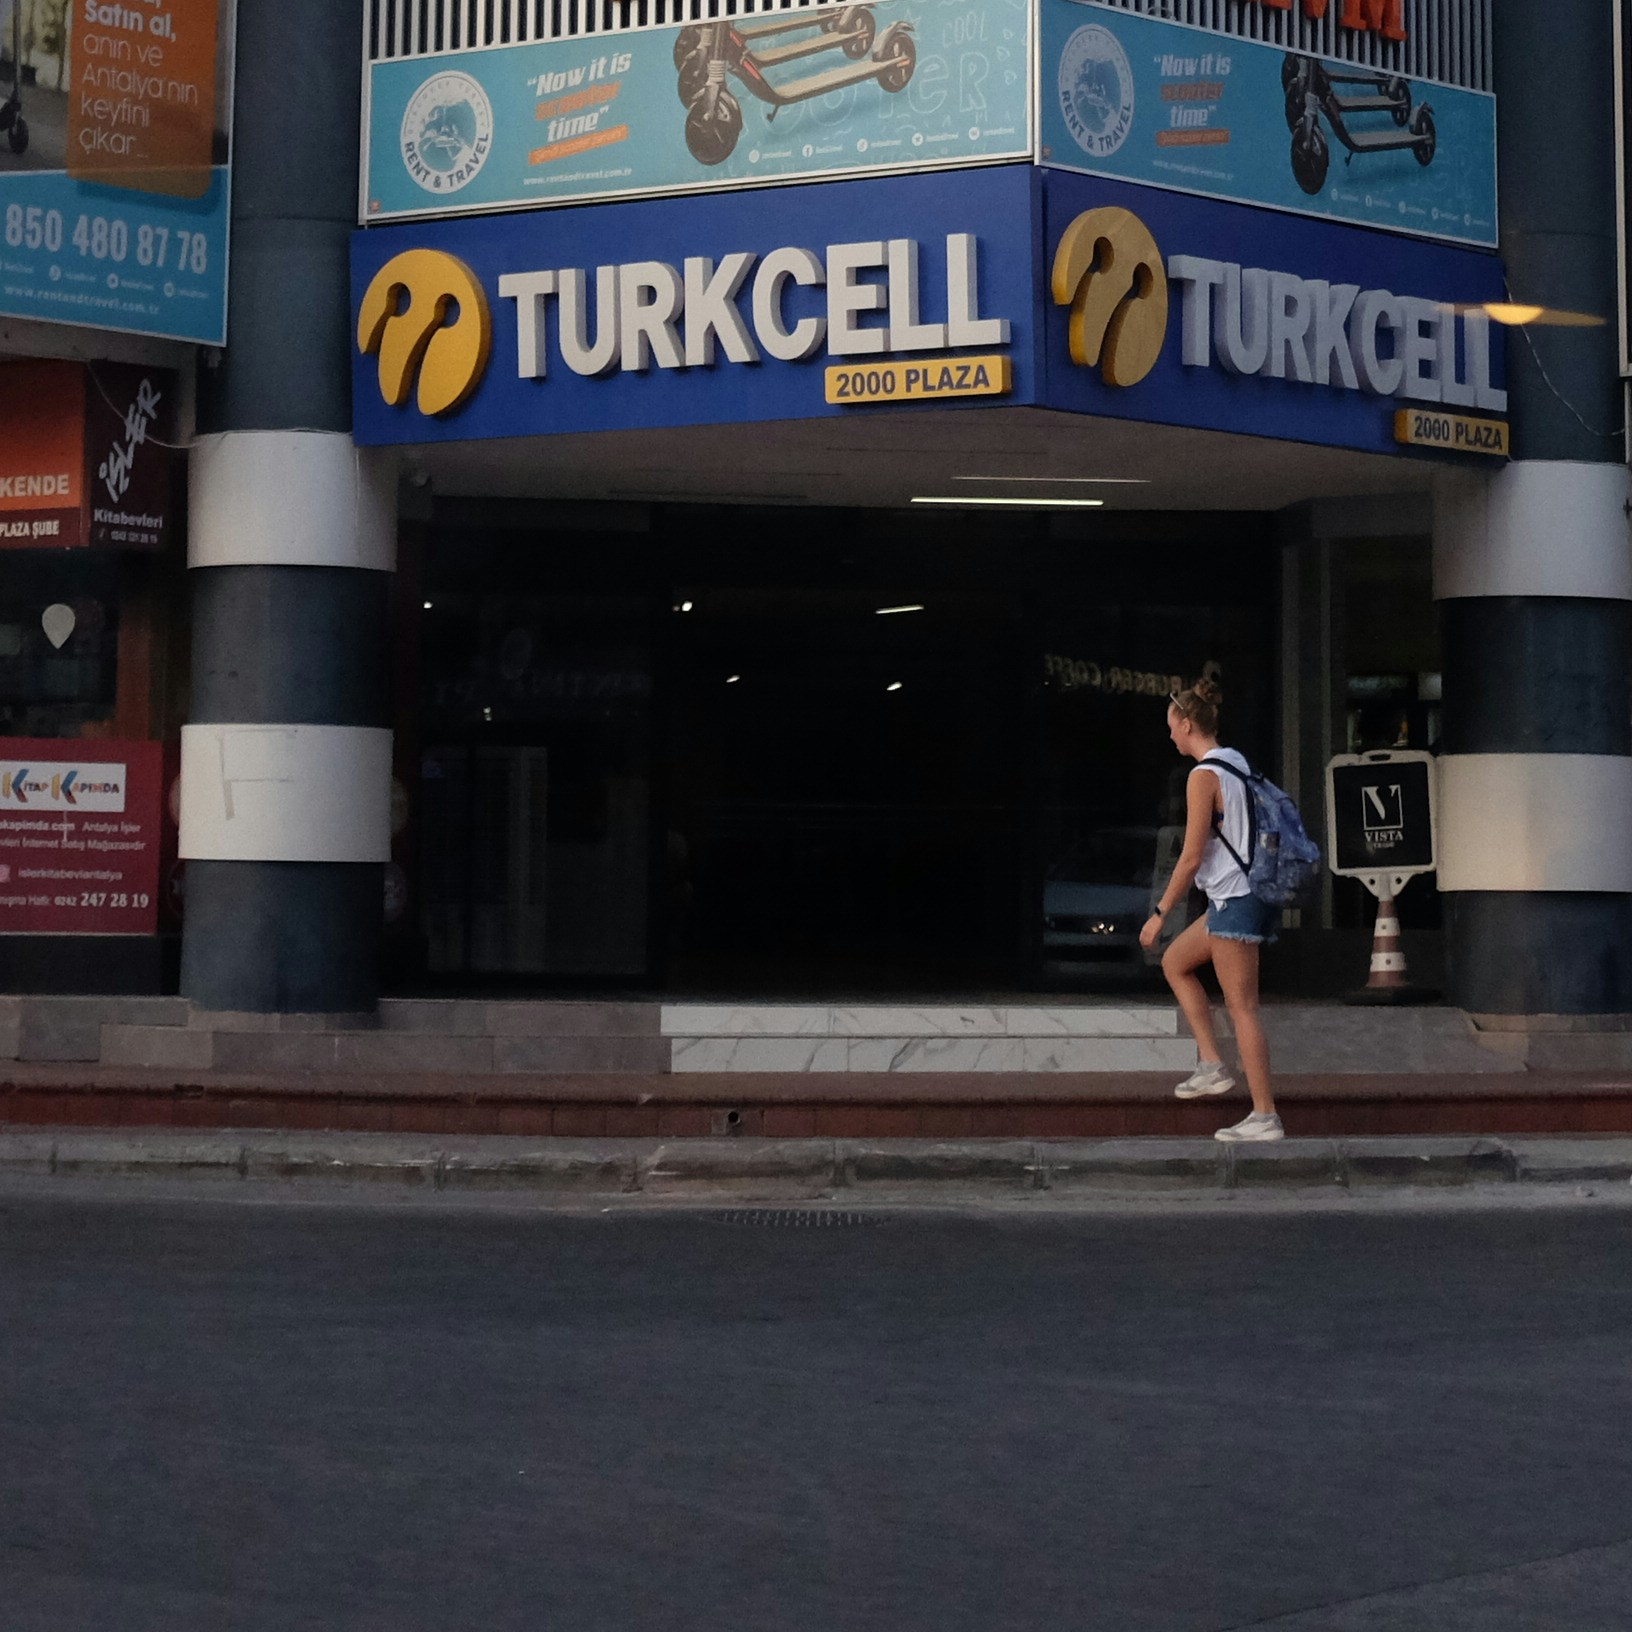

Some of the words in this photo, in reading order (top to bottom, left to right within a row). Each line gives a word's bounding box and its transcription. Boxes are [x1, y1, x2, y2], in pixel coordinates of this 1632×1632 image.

[84, 0, 144, 33] Satın
[148, 13, 177, 43] al,
[83, 33, 131, 61] anın
[137, 43, 164, 67] ve
[588, 56, 608, 81] it
[609, 52, 632, 75] is
[1200, 52, 1215, 75] it
[1215, 53, 1232, 76] is
[81, 91, 151, 128] keyfini
[1061, 89, 1085, 141] RENT
[1099, 103, 1132, 152] TRAVEL
[404, 141, 432, 183] RENT
[433, 173, 442, 189] &
[448, 131, 490, 188] TRAVEL
[5, 203, 64, 252] 850
[71, 214, 129, 262] 480
[136, 224, 169, 268] 87
[176, 230, 208, 274] 78
[498, 233, 1011, 380] TURKCELL
[1168, 254, 1508, 412] TURKCELL
[835, 367, 896, 398] 2000
[903, 364, 991, 395] PLAZA
[1414, 413, 1450, 443] 2000
[1454, 421, 1503, 451] PLAZA
[32, 520, 60, 539] ŞUBE
[93, 508, 163, 529] Kitabevleri
[1364, 830, 1404, 843] VISTA
[80, 892, 106, 908] 247
[110, 892, 128, 908] 28
[131, 893, 149, 909] 19
